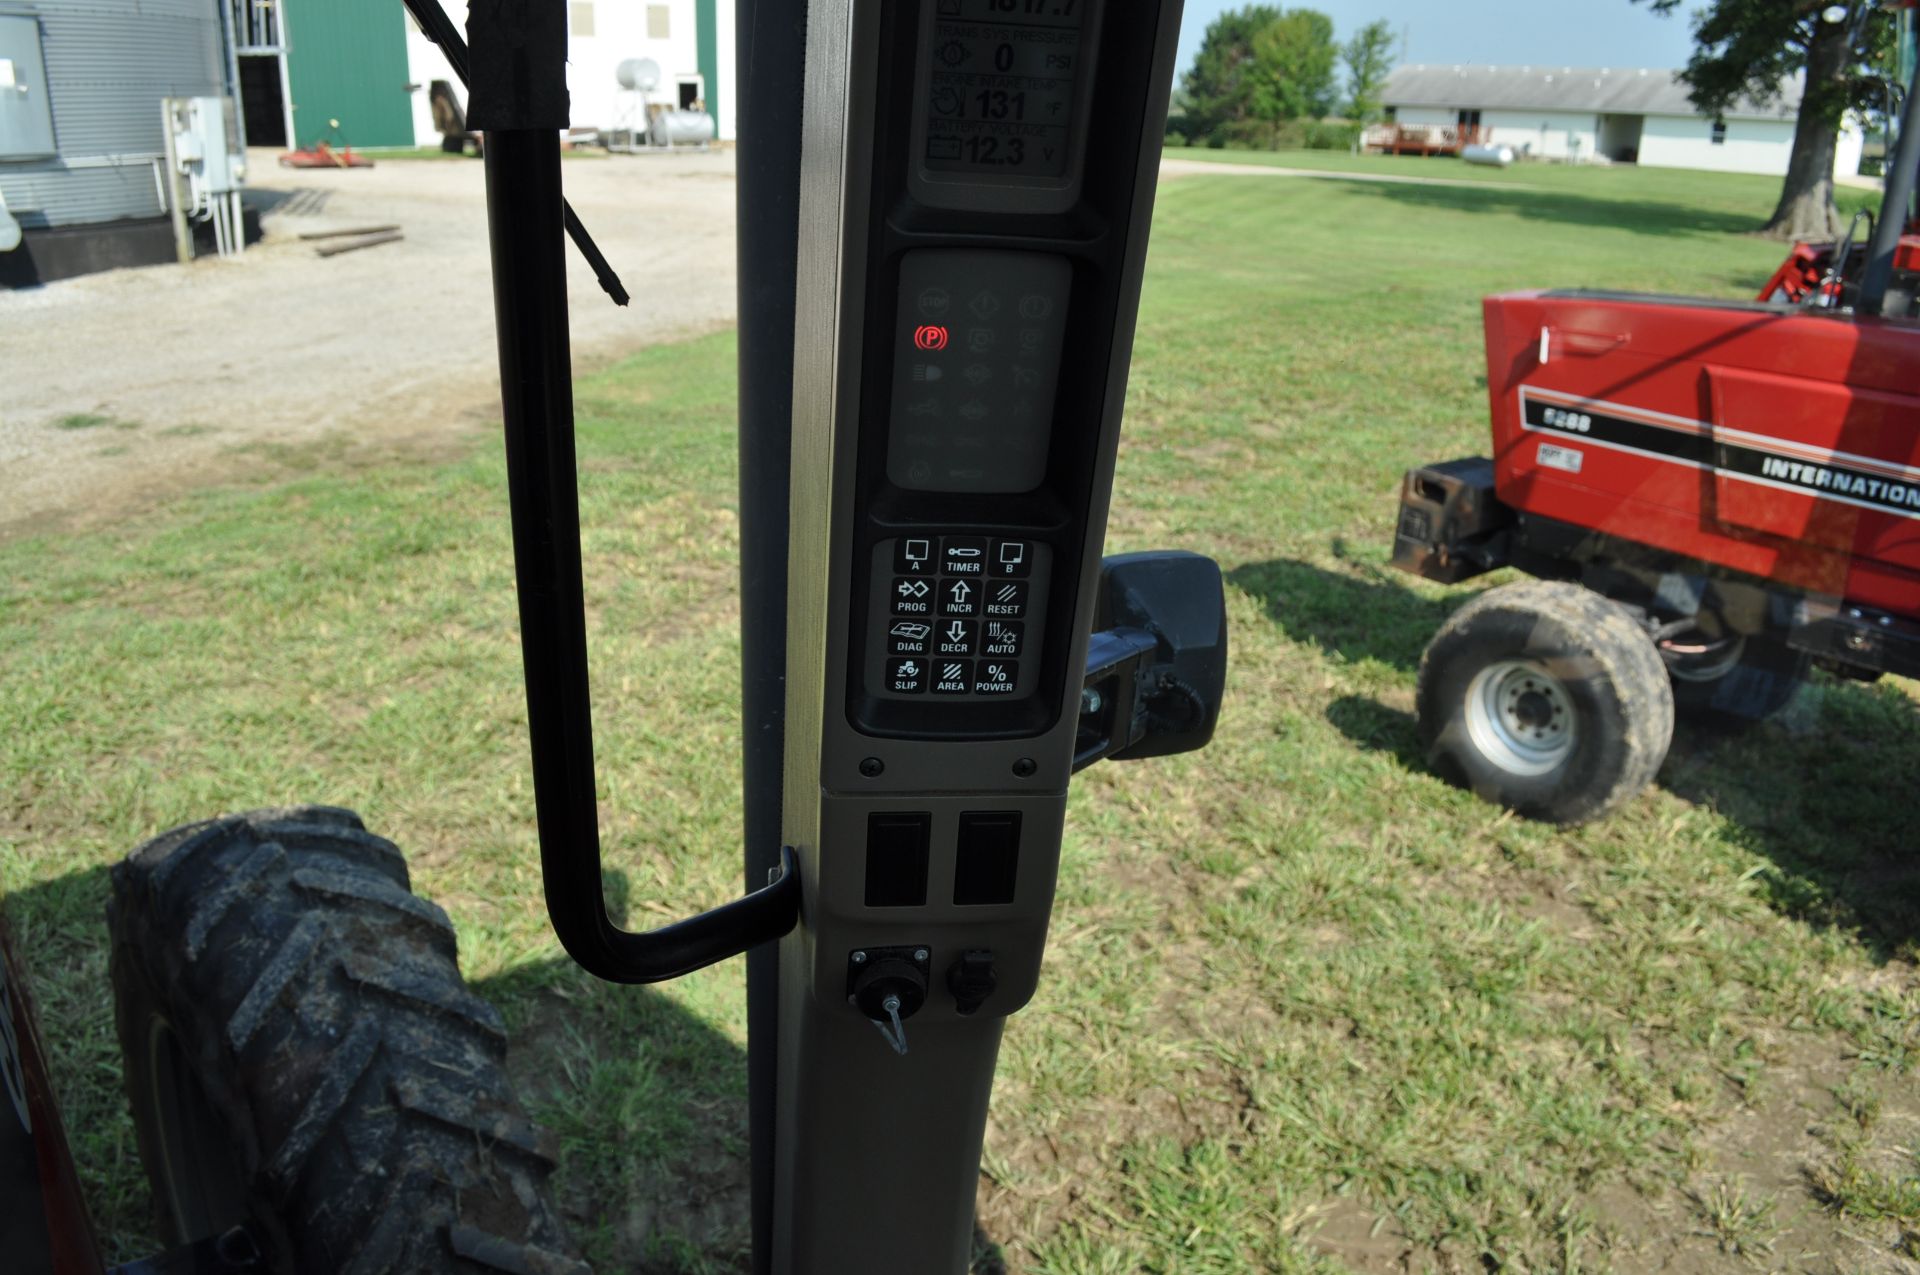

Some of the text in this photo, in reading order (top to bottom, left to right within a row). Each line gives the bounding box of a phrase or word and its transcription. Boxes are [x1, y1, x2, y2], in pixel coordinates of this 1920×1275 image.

[982, 27, 1009, 40] SYS
[994, 43, 1015, 73] 0
[1046, 54, 1072, 70] PSI
[975, 89, 1025, 120] 131
[991, 123, 1049, 137] VOLTAGE
[965, 135, 1025, 166] 12.3
[1042, 147, 1055, 161] V
[912, 562, 920, 571] A
[947, 562, 980, 572] TIMER
[1005, 564, 1014, 573] B
[897, 602, 926, 612] PROG
[947, 603, 972, 613] INCR
[987, 604, 1020, 614] RESET
[897, 642, 923, 651] DIAG
[941, 643, 968, 652] DECR
[987, 644, 1015, 654] AUTO
[895, 681, 917, 690] SLIP
[937, 682, 964, 691] AREA
[976, 682, 1013, 692] POWER
